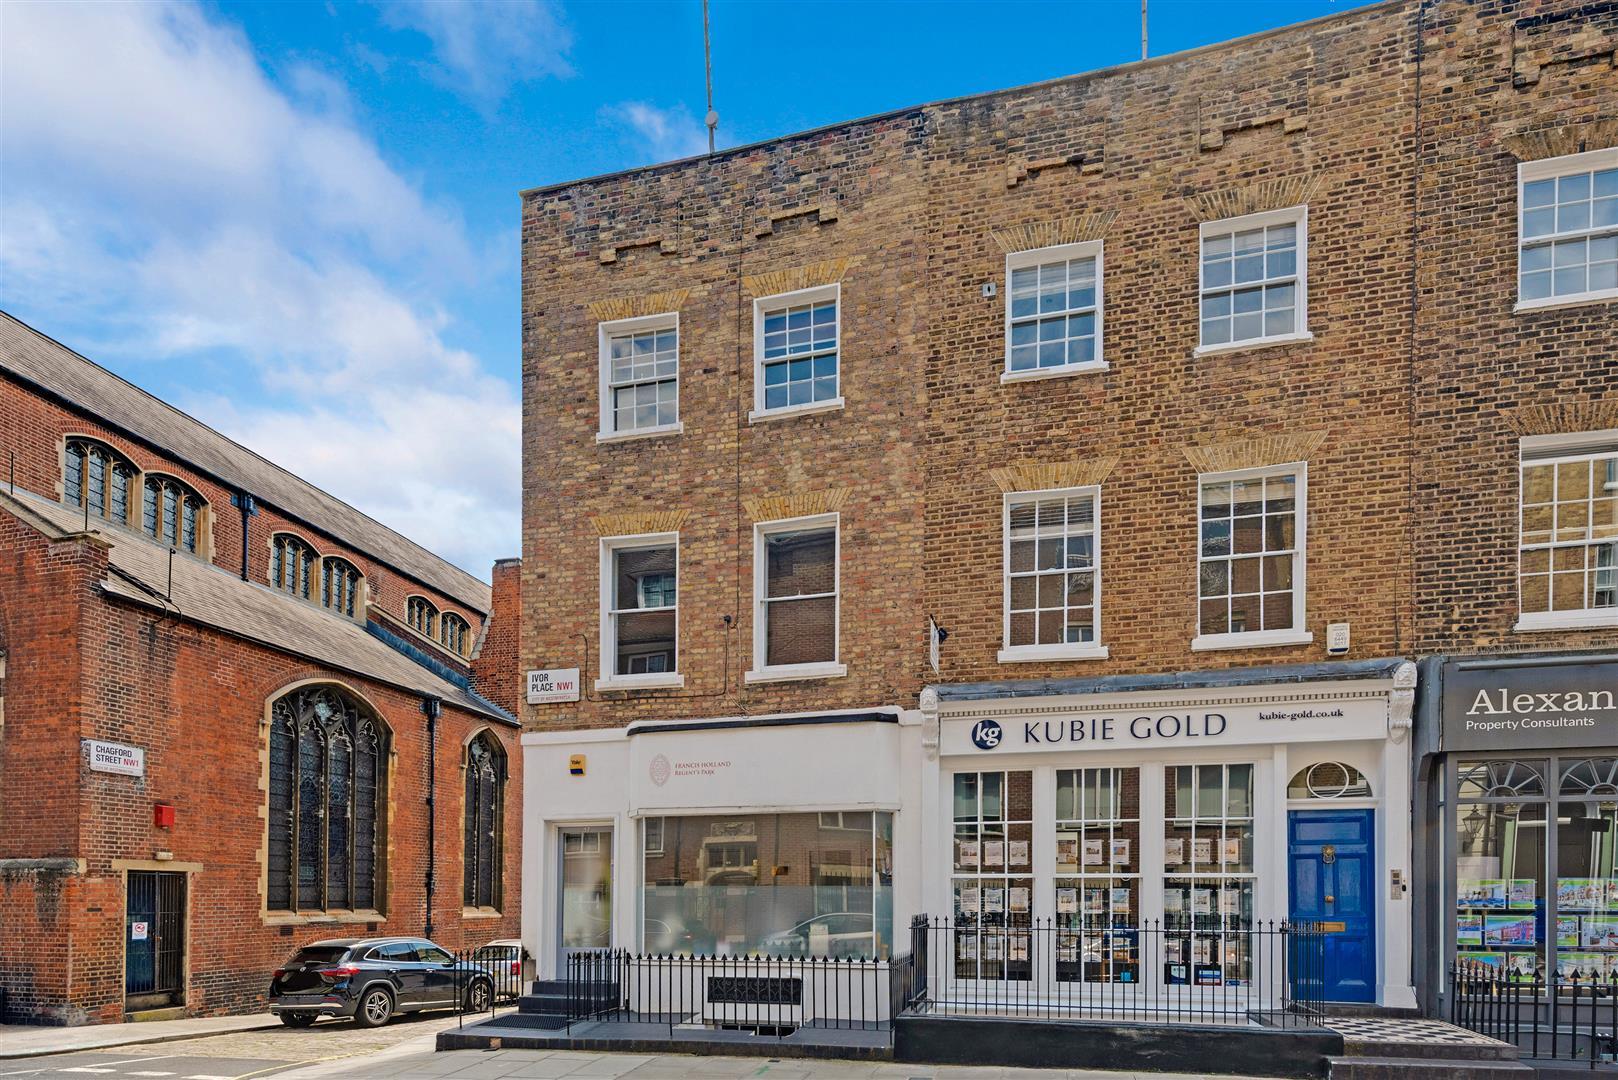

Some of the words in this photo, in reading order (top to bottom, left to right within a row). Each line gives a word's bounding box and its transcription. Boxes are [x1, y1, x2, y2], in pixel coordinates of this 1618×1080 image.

[531, 673, 549, 682] IVOR
[531, 682, 554, 692] PLACE
[556, 681, 573, 690] NW1
[1466, 688, 1617, 715] Alexan
[1259, 709, 1344, 721] kubie-gold.co.uk
[975, 722, 1001, 746] kg
[1024, 718, 1115, 743] KUBIE
[1129, 713, 1227, 739] GOLD
[1466, 719, 1519, 732] Property
[1521, 716, 1595, 729] Consultants
[96, 745, 132, 757] CHAGFORD
[96, 754, 121, 764] STREET
[124, 758, 138, 767] NW1
